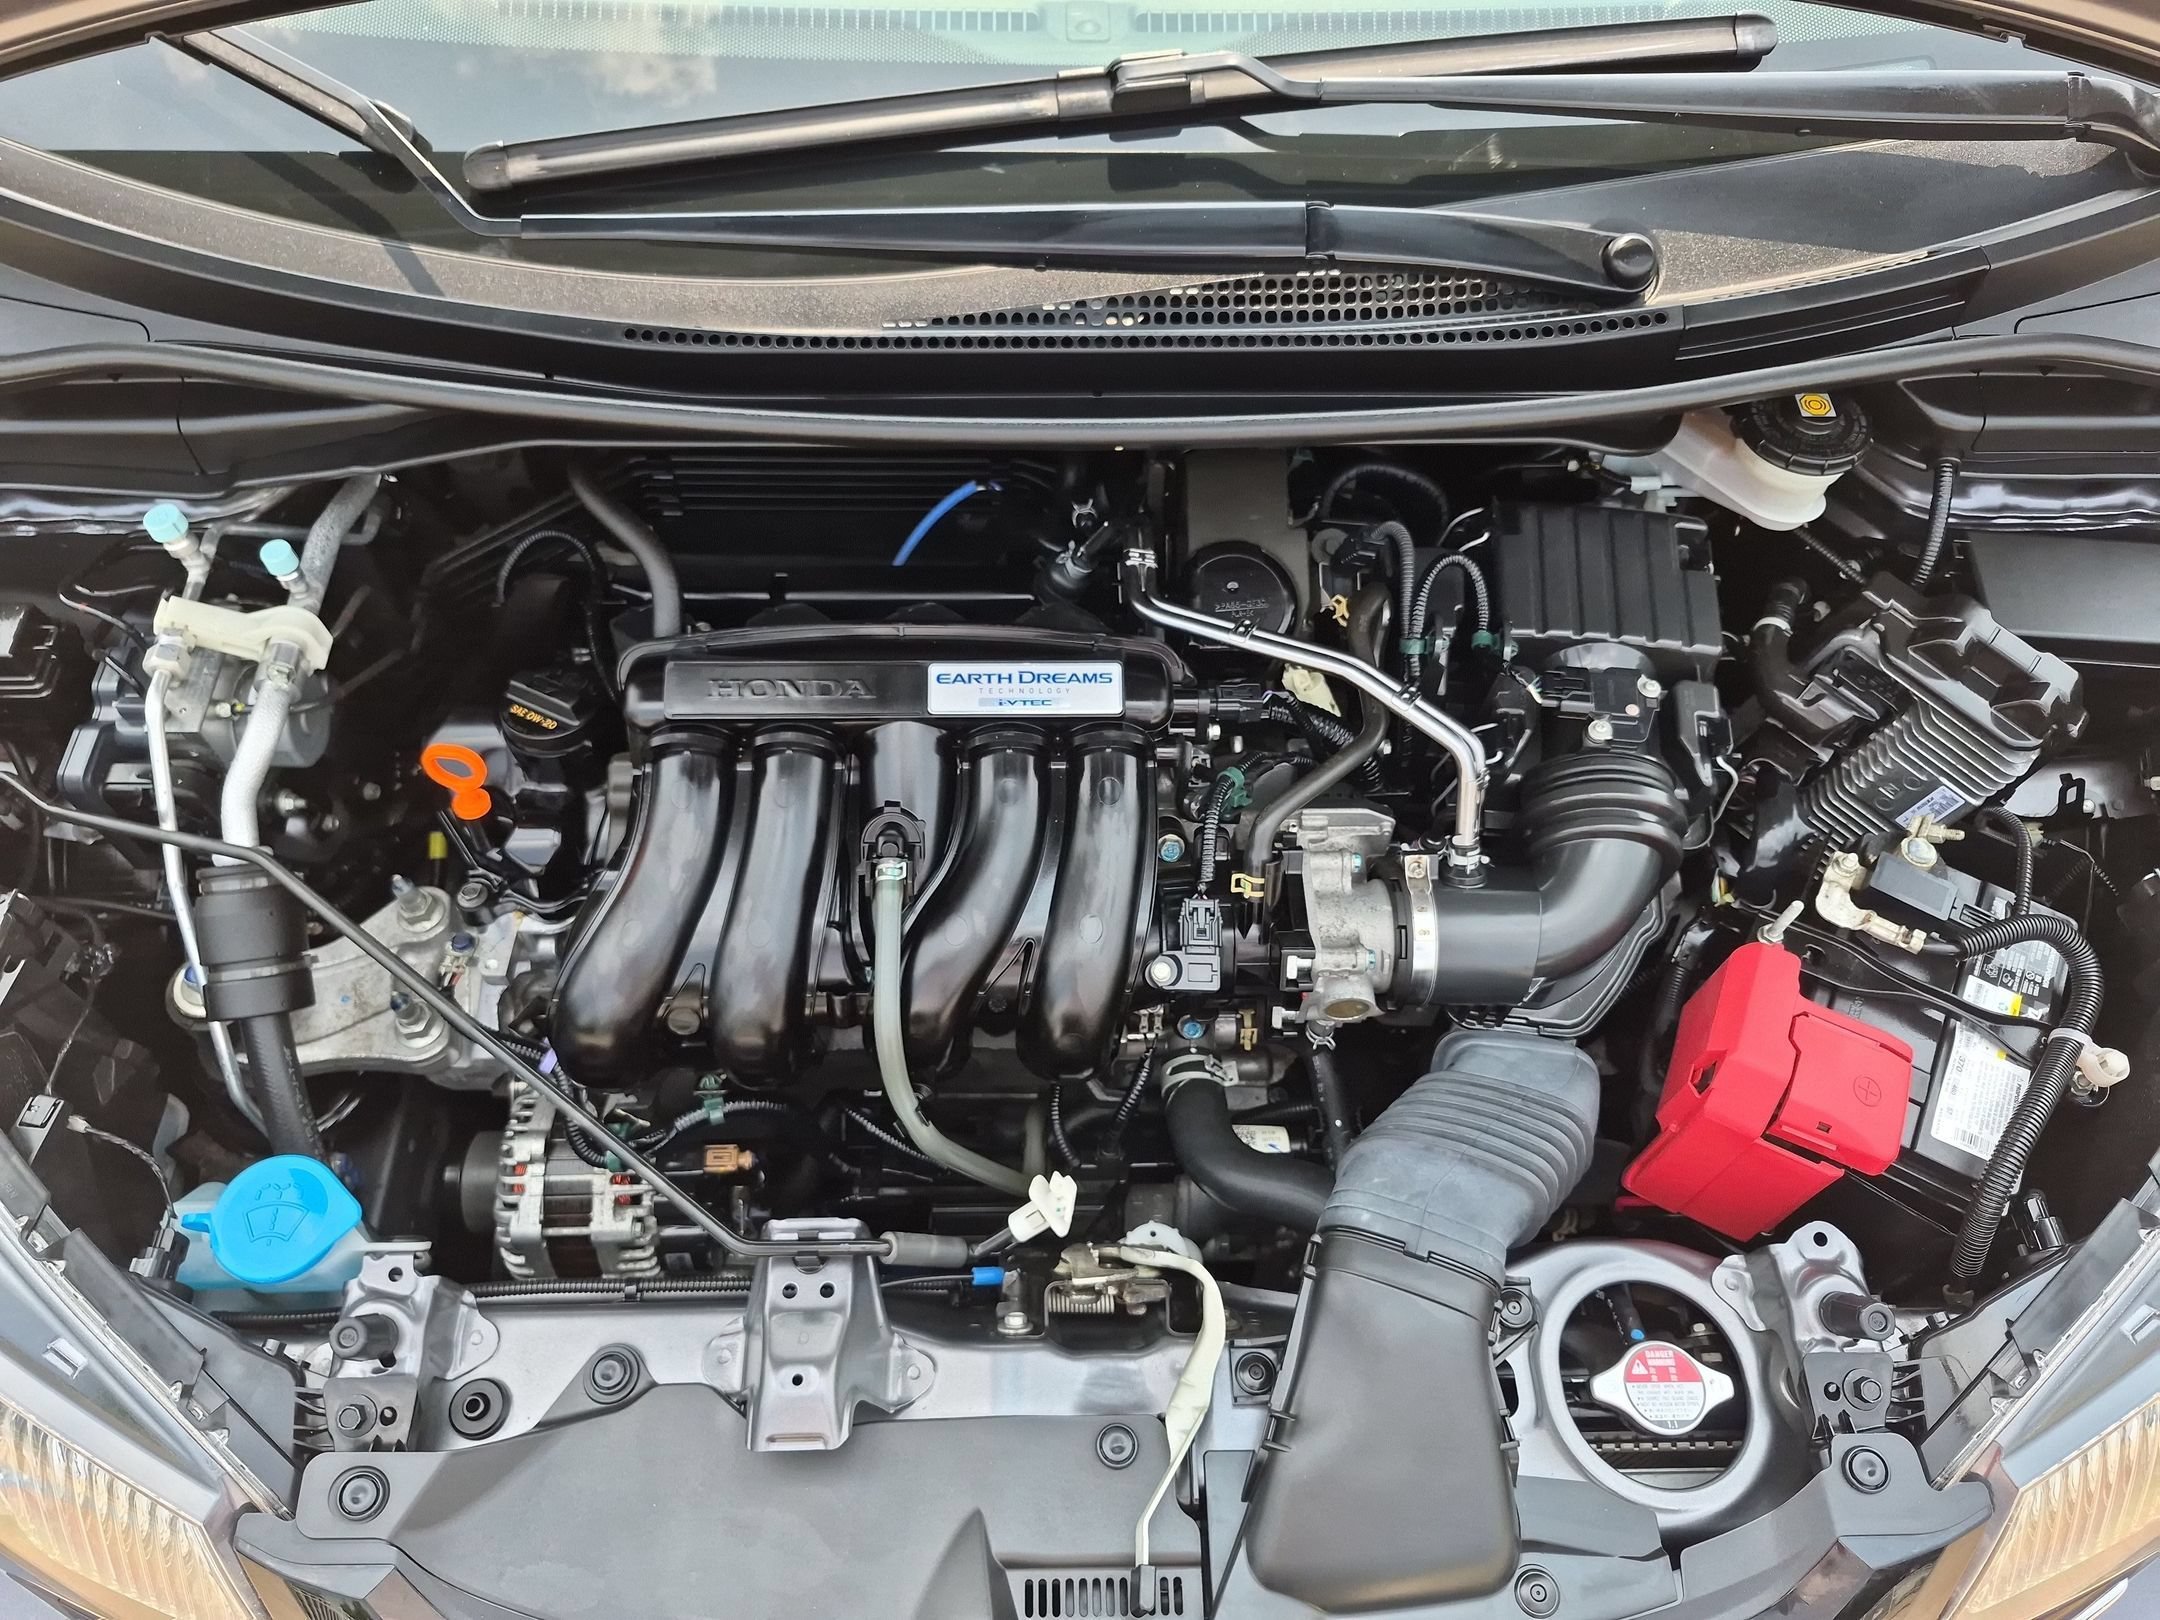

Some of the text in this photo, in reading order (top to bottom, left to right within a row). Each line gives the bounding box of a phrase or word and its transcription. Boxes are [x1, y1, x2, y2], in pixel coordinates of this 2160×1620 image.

[936, 671, 1113, 685] EARTH DREAMS
[707, 679, 877, 699] HONDA
[509, 704, 529, 717] SAE
[1645, 1350, 1674, 1358] DANGER
[1667, 1420, 1679, 1429] 1.1
